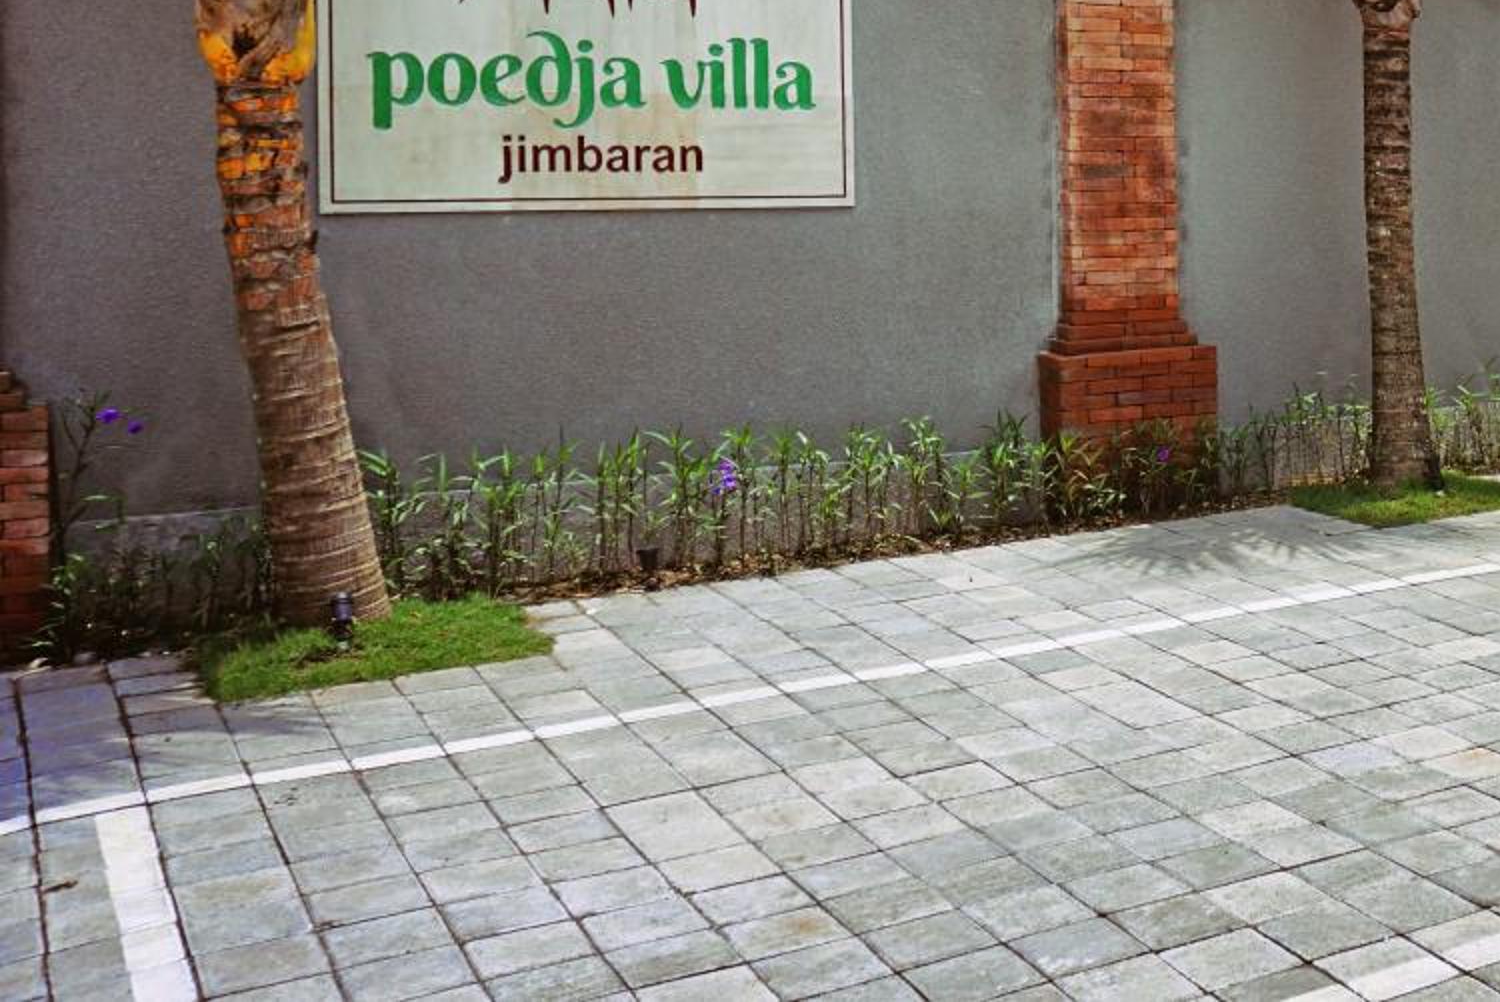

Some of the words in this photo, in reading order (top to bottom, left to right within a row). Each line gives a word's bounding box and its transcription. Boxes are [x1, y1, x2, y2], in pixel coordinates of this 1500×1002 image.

[367, 31, 646, 130] poedja
[659, 37, 817, 111] villa
[498, 135, 703, 184] jimbaran
